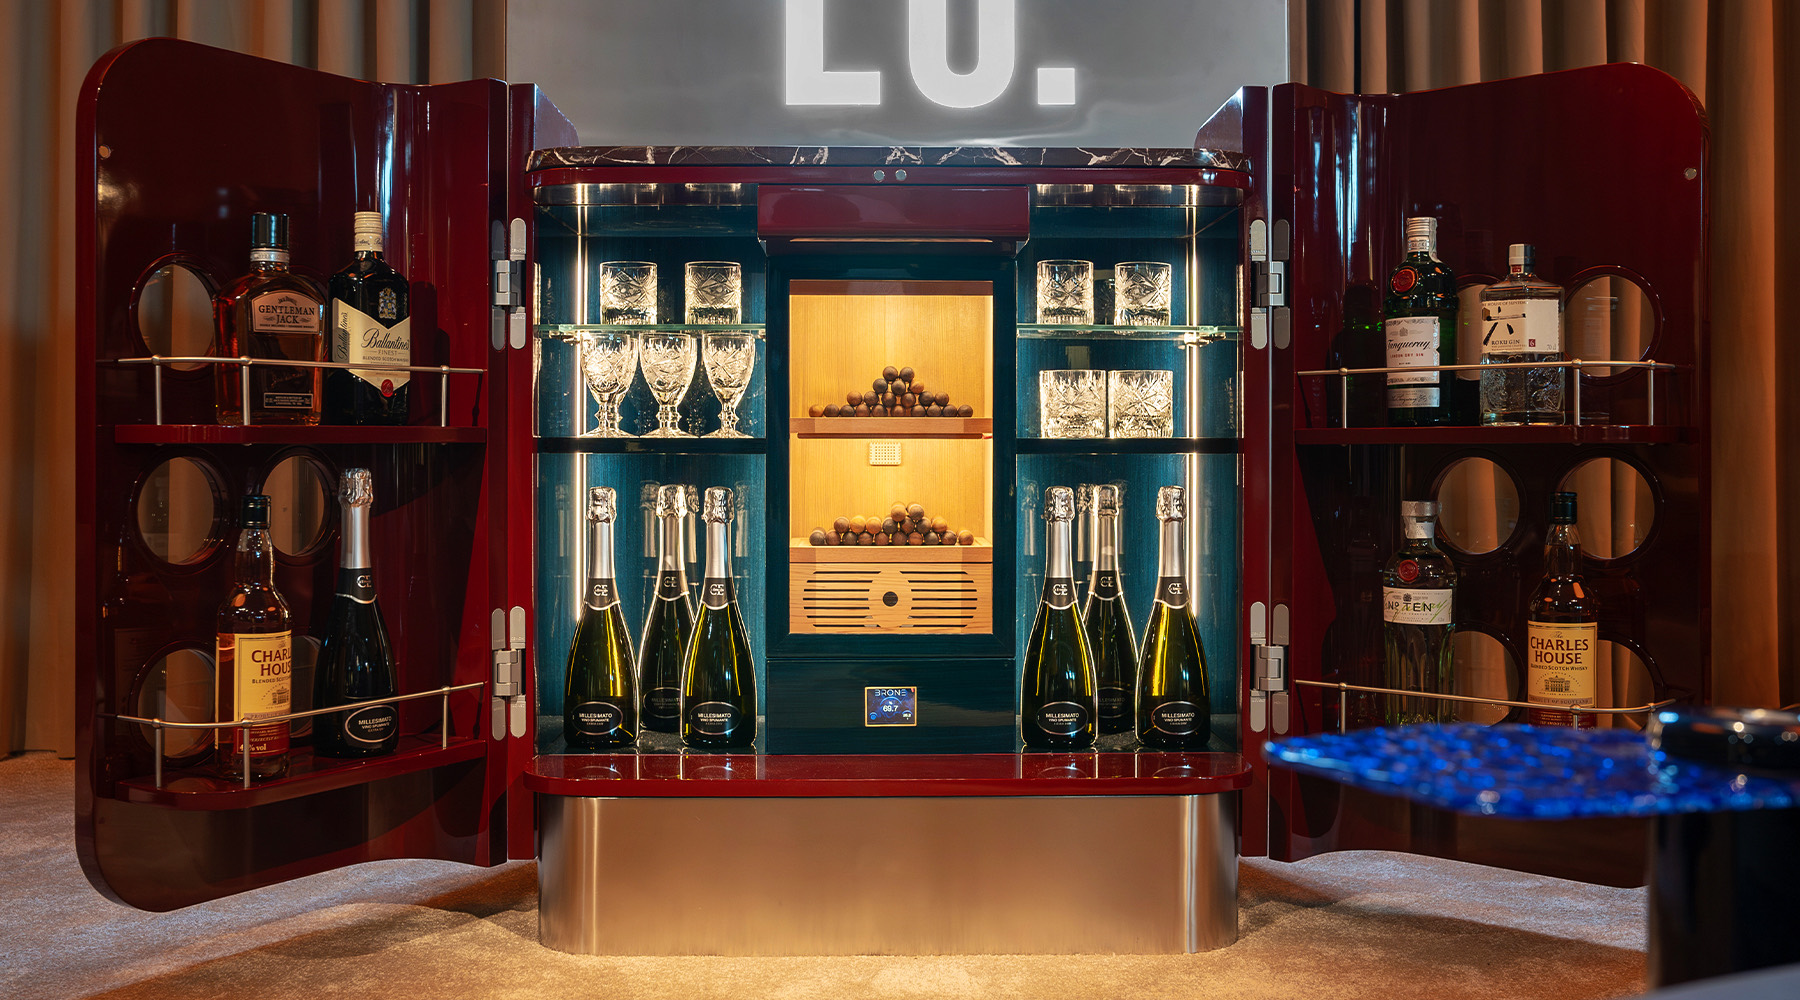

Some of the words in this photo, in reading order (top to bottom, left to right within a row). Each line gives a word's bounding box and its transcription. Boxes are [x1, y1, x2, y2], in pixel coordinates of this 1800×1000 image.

[258, 304, 315, 316] GENTLEMAN
[276, 314, 300, 324] JACK
[1387, 340, 1430, 352] Tanqueray
[1403, 602, 1432, 612] TEN
[1530, 636, 1589, 651] CHARLES
[1535, 650, 1583, 664] HOUSE
[358, 716, 392, 725] MILLESIMATO
